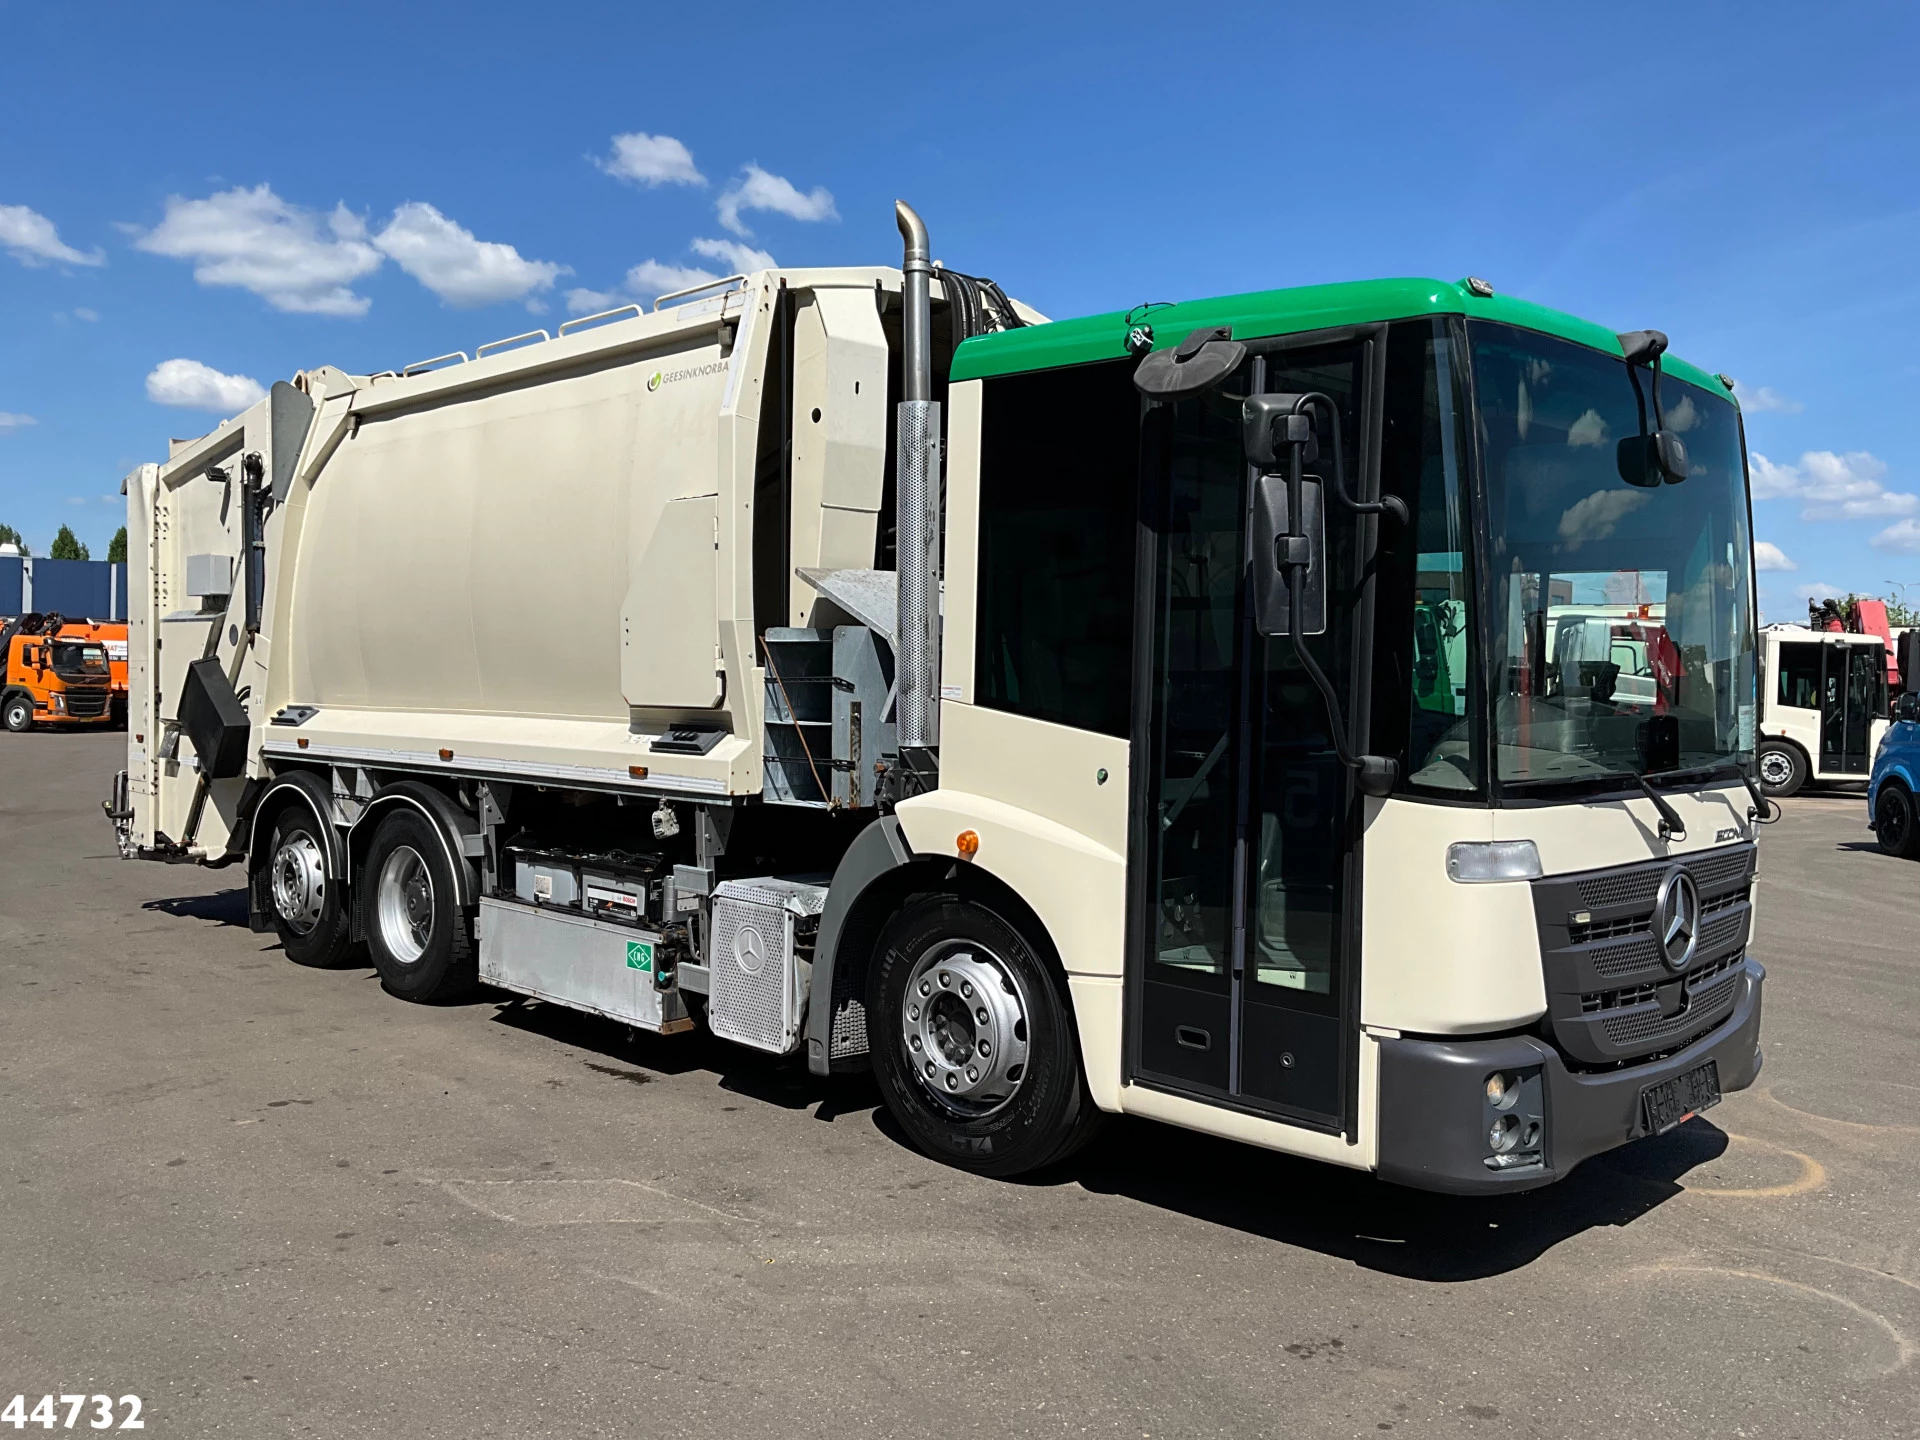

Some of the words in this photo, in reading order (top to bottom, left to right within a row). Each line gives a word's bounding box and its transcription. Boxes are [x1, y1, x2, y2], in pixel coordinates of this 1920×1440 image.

[662, 361, 729, 384] GEESINKNORBA
[622, 896, 636, 904] BOSCH
[633, 951, 645, 962] CNG
